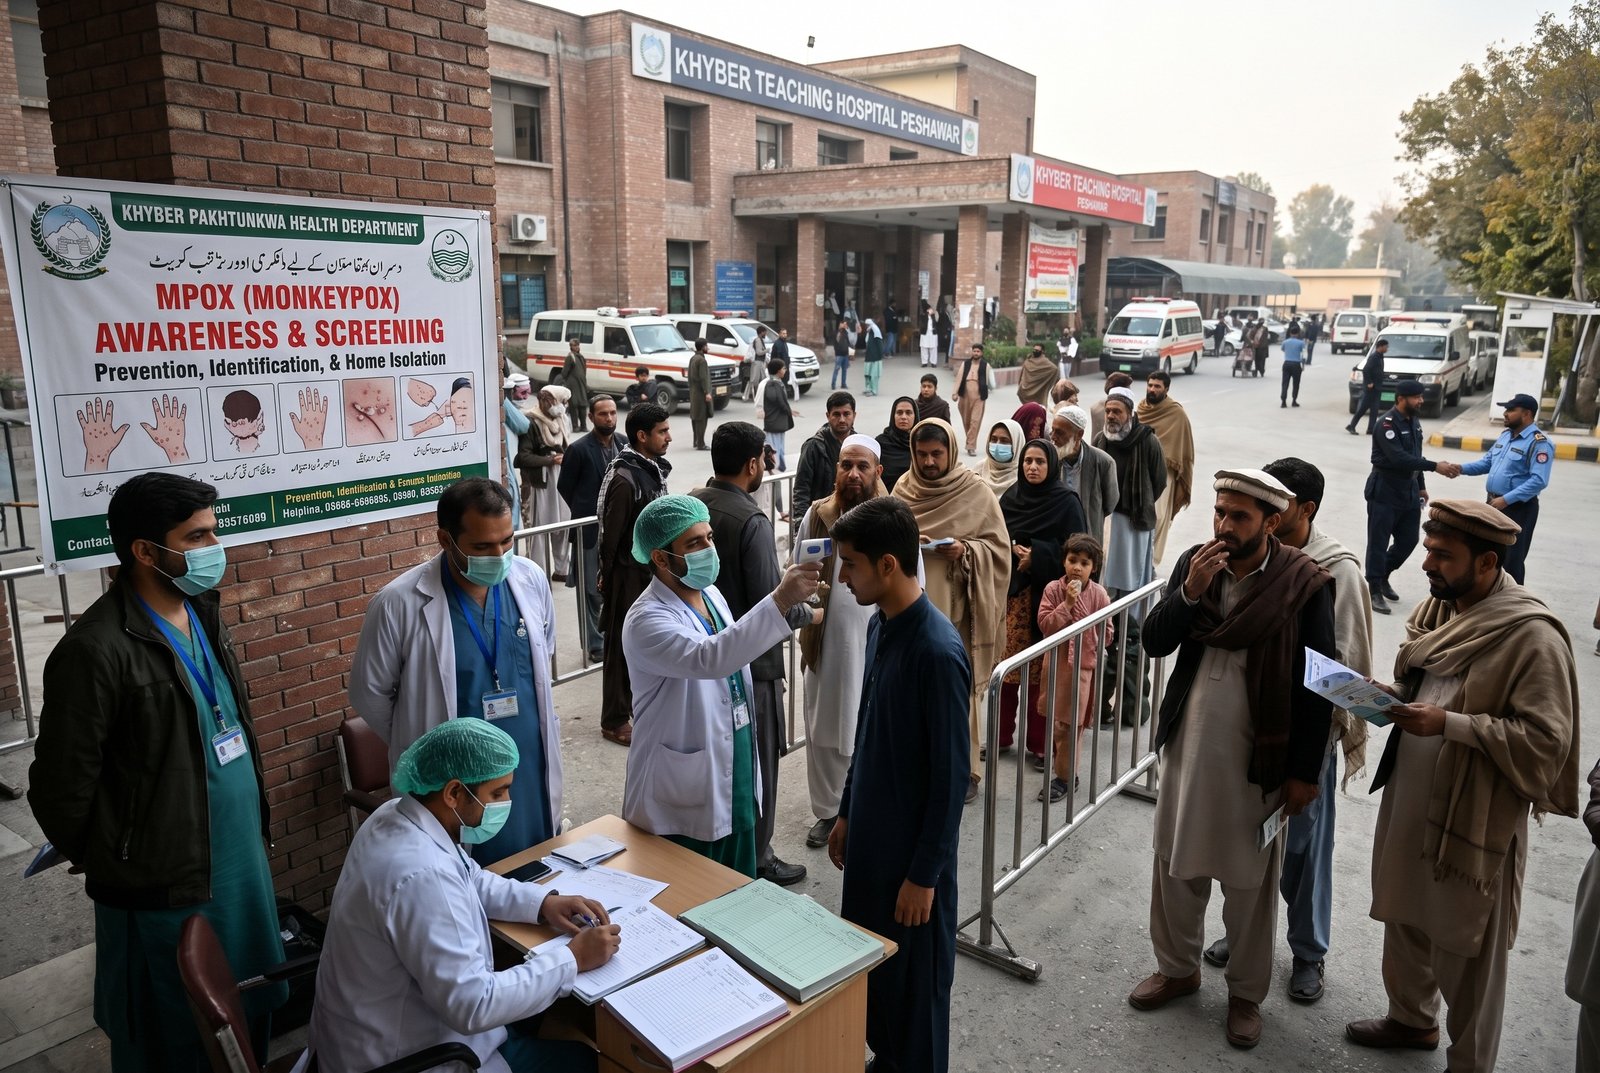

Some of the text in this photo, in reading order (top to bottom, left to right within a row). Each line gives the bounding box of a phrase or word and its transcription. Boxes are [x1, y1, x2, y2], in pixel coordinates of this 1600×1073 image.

[675, 47, 961, 145] KHYBER TEACHING HOSPITAL PESHAWAR
[1036, 165, 1072, 190] KHYBER
[1073, 174, 1111, 199] TEACHING
[121, 203, 419, 238] KHYBER PAKHTUNKWA HEALTH DEPARTMENT
[155, 283, 400, 315] MPOX (MONKEYPOX)
[95, 318, 445, 354] AWARENESS & SCREENING
[94, 351, 447, 382] Prevention, Identification, & Home Isolation
[285, 489, 335, 504] Prevention,
[389, 479, 396, 489] &
